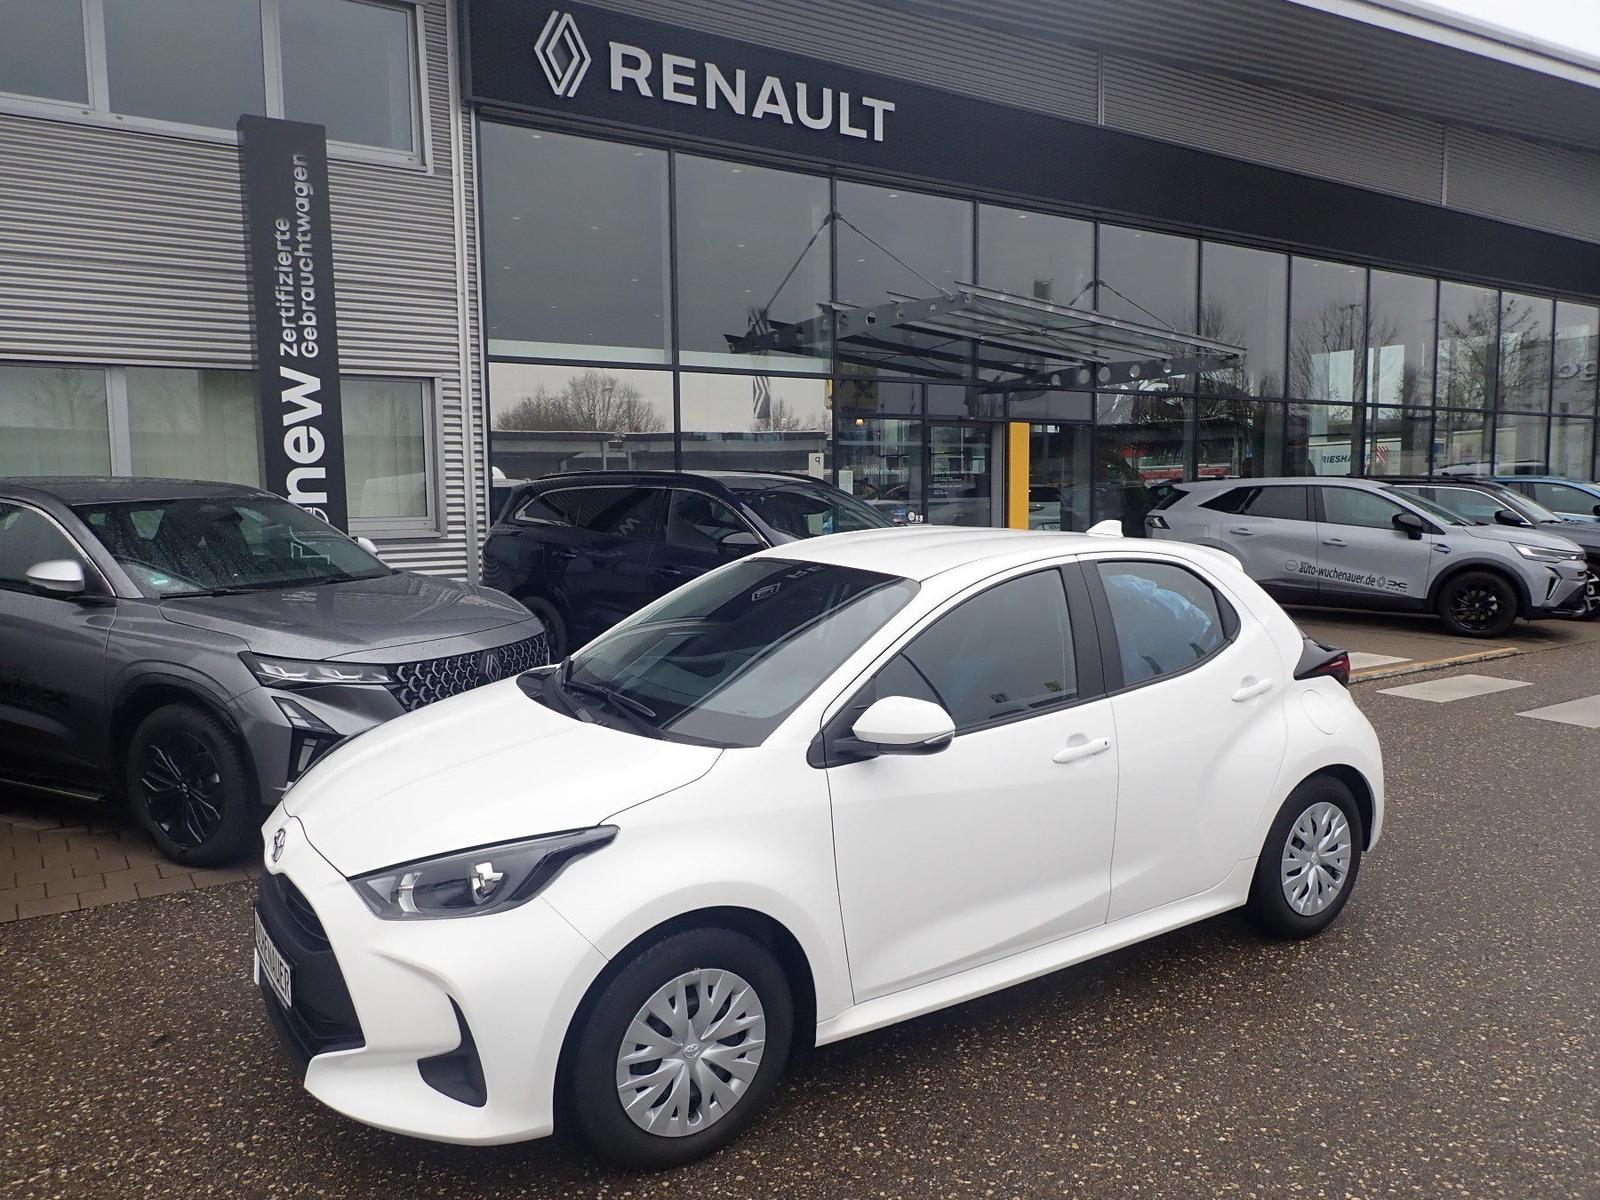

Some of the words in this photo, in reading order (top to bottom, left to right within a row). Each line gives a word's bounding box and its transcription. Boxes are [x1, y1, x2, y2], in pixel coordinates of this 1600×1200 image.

[609, 41, 895, 142] RENAULT
[274, 217, 298, 357] Zertifizierte
[293, 154, 318, 358] Gebrauchtwagen
[280, 366, 329, 523] new
[1298, 563, 1376, 587] auto-wuchenauer.de
